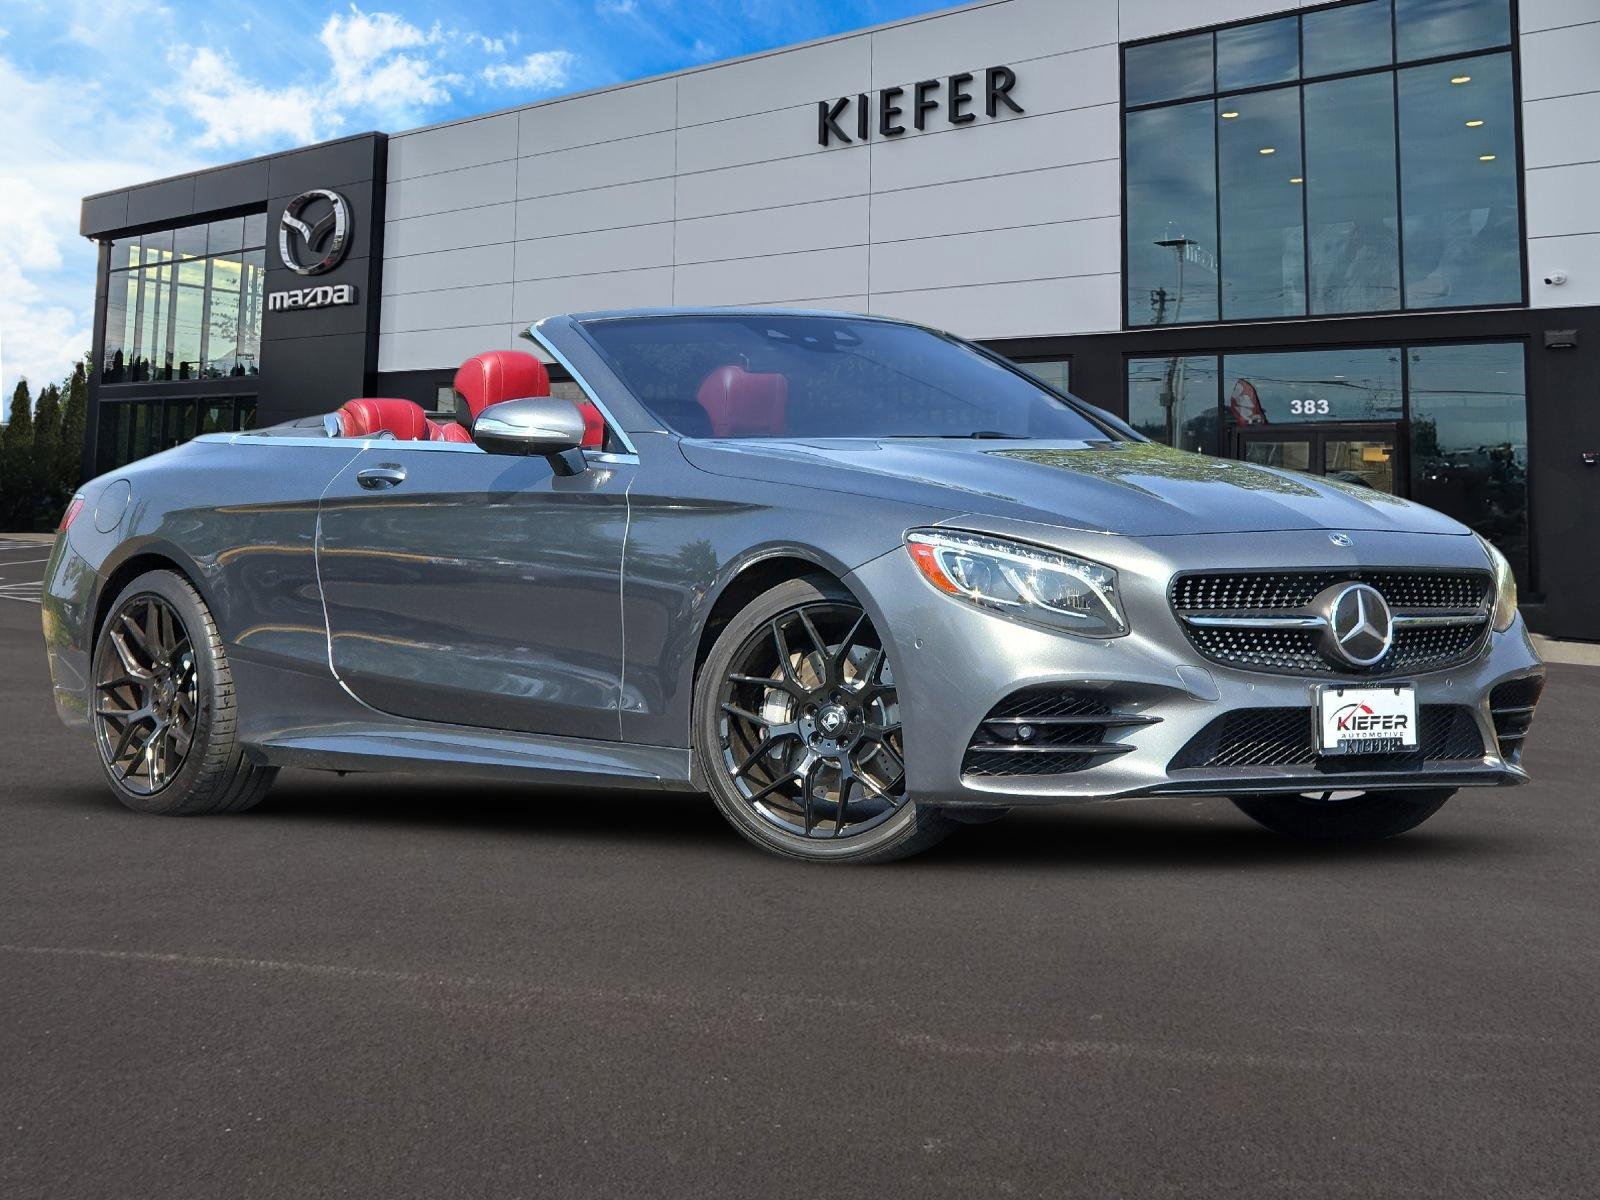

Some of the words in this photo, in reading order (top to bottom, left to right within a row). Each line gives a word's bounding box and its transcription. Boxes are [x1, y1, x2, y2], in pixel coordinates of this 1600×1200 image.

[818, 66, 1025, 147] KIEFER
[268, 284, 354, 311] mazda
[1291, 400, 1329, 414] 383
[1337, 714, 1408, 730] KIEFER
